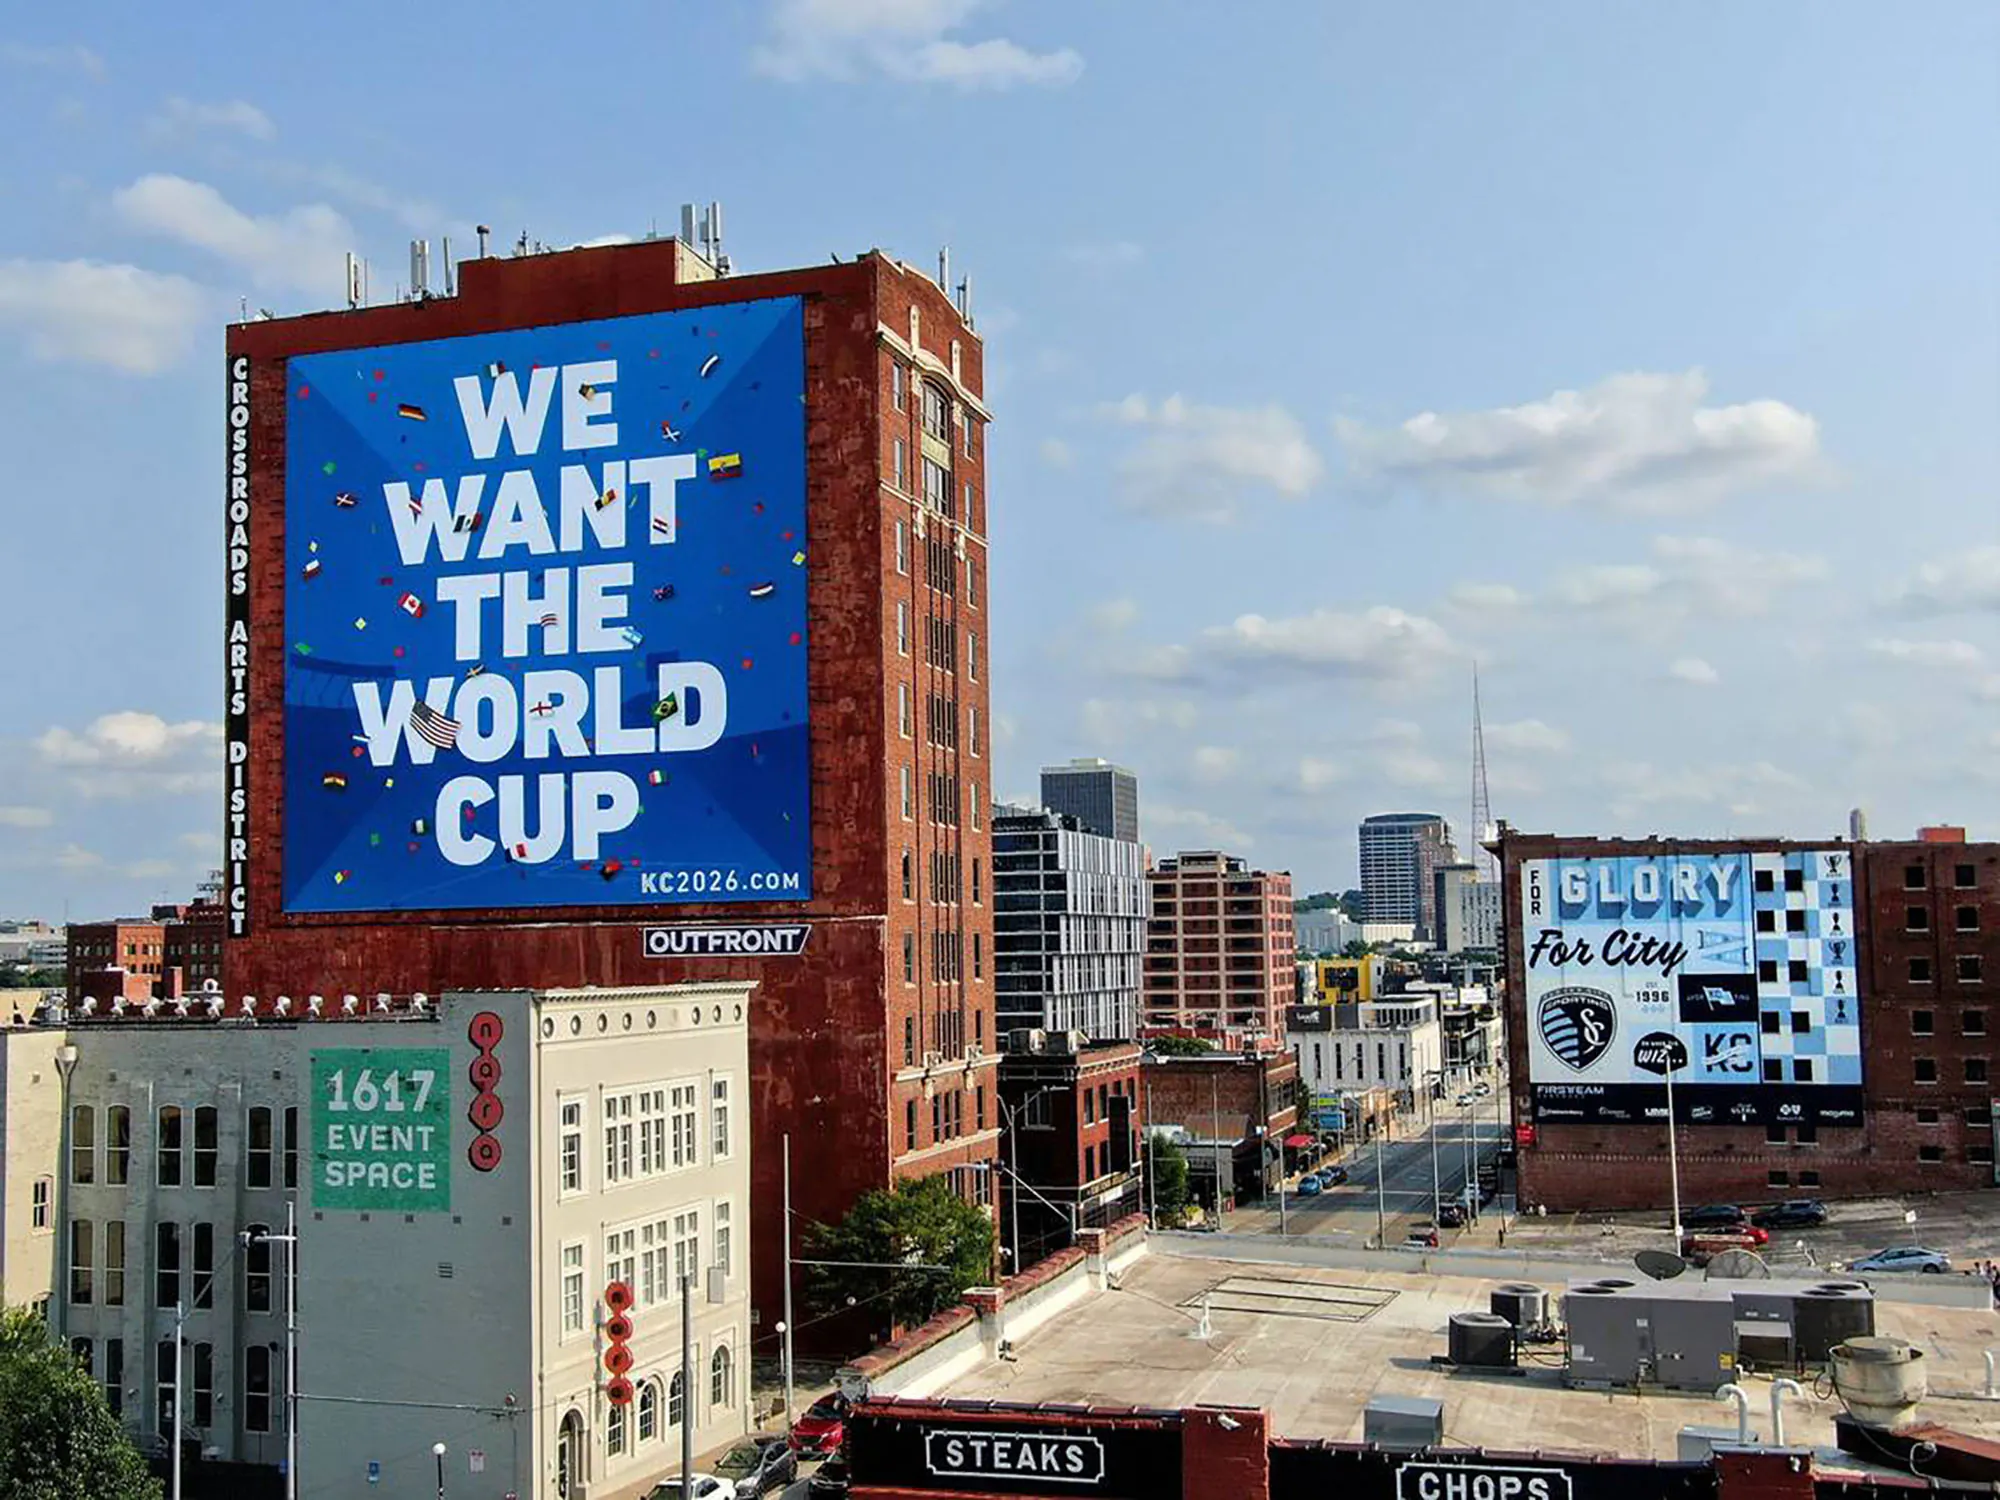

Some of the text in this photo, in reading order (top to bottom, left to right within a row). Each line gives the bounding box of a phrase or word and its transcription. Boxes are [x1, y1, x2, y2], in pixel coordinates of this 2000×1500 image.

[454, 360, 618, 459] WE
[383, 453, 697, 566] WANT
[437, 562, 634, 661] THE
[229, 357, 249, 934] CROSSROADS ARTS DISTRICT
[352, 661, 727, 767] WORLD
[435, 771, 640, 866] CUP
[641, 870, 799, 893] KC2026.COM
[1530, 869, 1541, 915] FOR
[1559, 864, 1738, 910] GLORY
[649, 929, 800, 954] OUTFRONT
[1529, 928, 1688, 978] For City
[329, 1069, 435, 1112] 1617
[328, 1124, 435, 1151] EVENT
[325, 1160, 436, 1189] SPACE
[946, 1440, 1084, 1473] STEAKS
[1419, 1472, 1549, 1500] CHOPS
